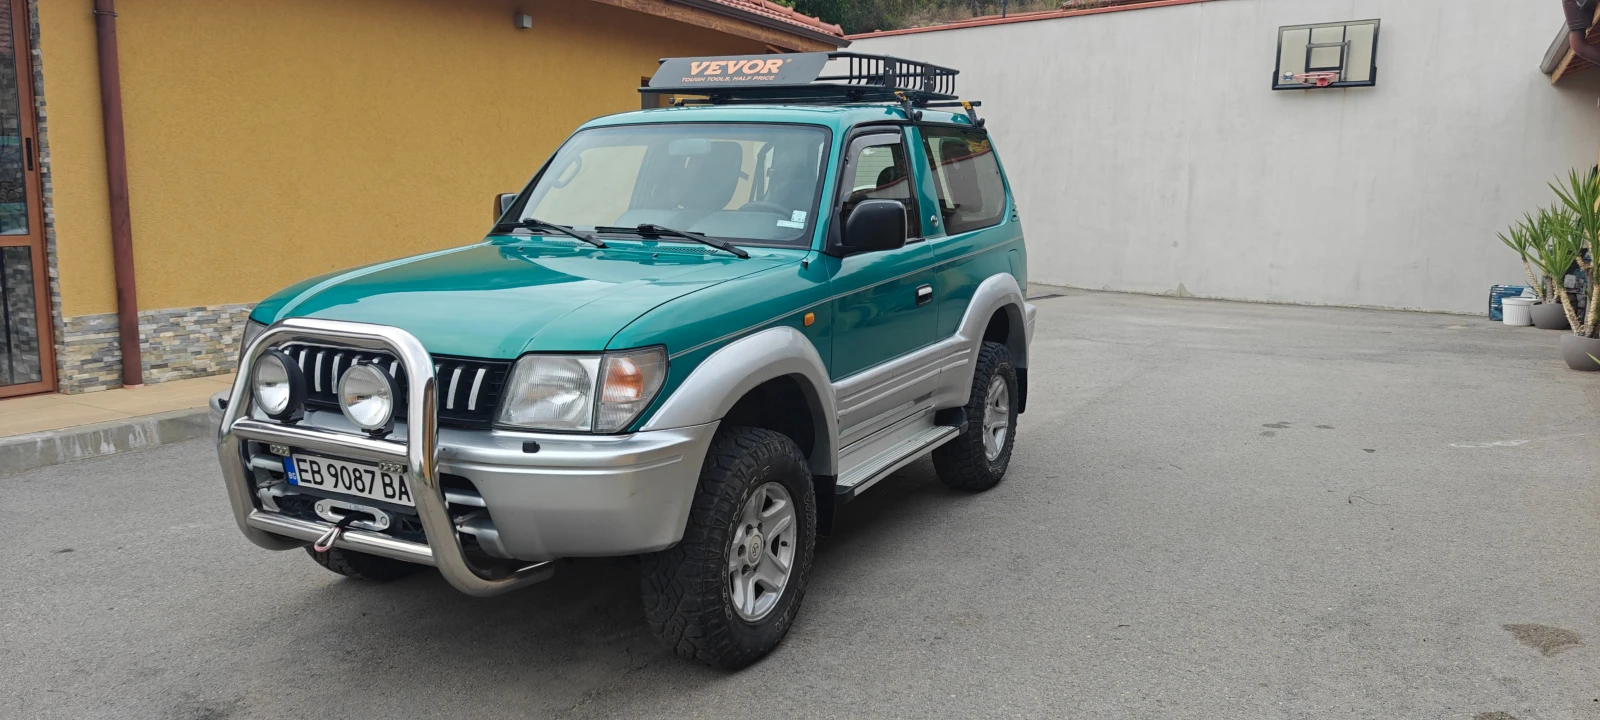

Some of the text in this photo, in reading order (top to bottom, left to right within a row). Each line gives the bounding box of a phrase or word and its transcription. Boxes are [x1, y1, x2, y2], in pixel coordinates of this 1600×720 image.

[690, 59, 784, 76] VEVOR
[288, 472, 297, 480] BG
[296, 458, 412, 503] EB 9087 BA
